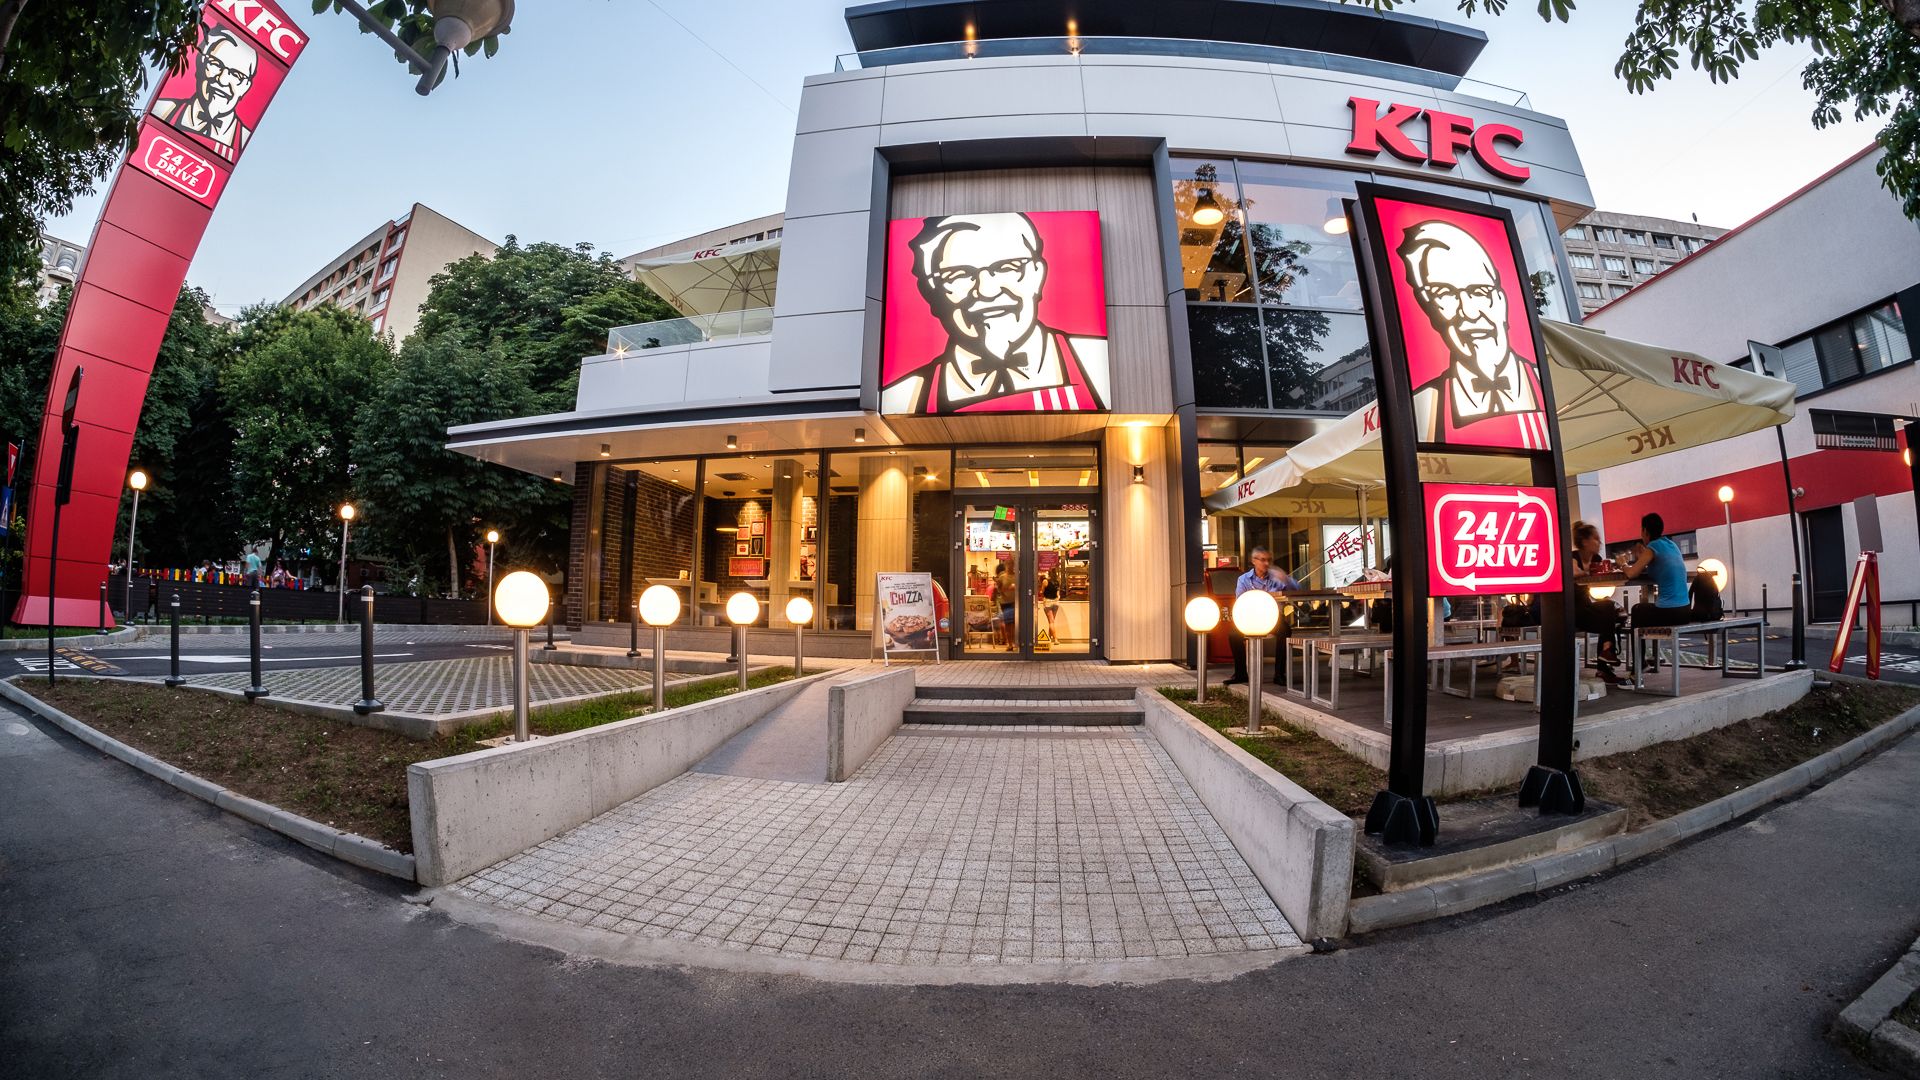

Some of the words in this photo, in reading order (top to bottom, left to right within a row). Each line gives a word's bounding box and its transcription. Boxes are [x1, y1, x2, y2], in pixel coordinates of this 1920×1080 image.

[216, 0, 301, 58] KFC
[1345, 96, 1530, 184] KFC
[156, 158, 199, 187] DRIVE
[160, 147, 205, 177] 24/7
[693, 249, 722, 260] KFC
[1671, 356, 1720, 389] KFC
[1237, 480, 1255, 500] KFC
[1453, 511, 1537, 544] 24/7
[1455, 544, 1540, 568] DRIVE
[889, 590, 923, 606] CHIZZA
